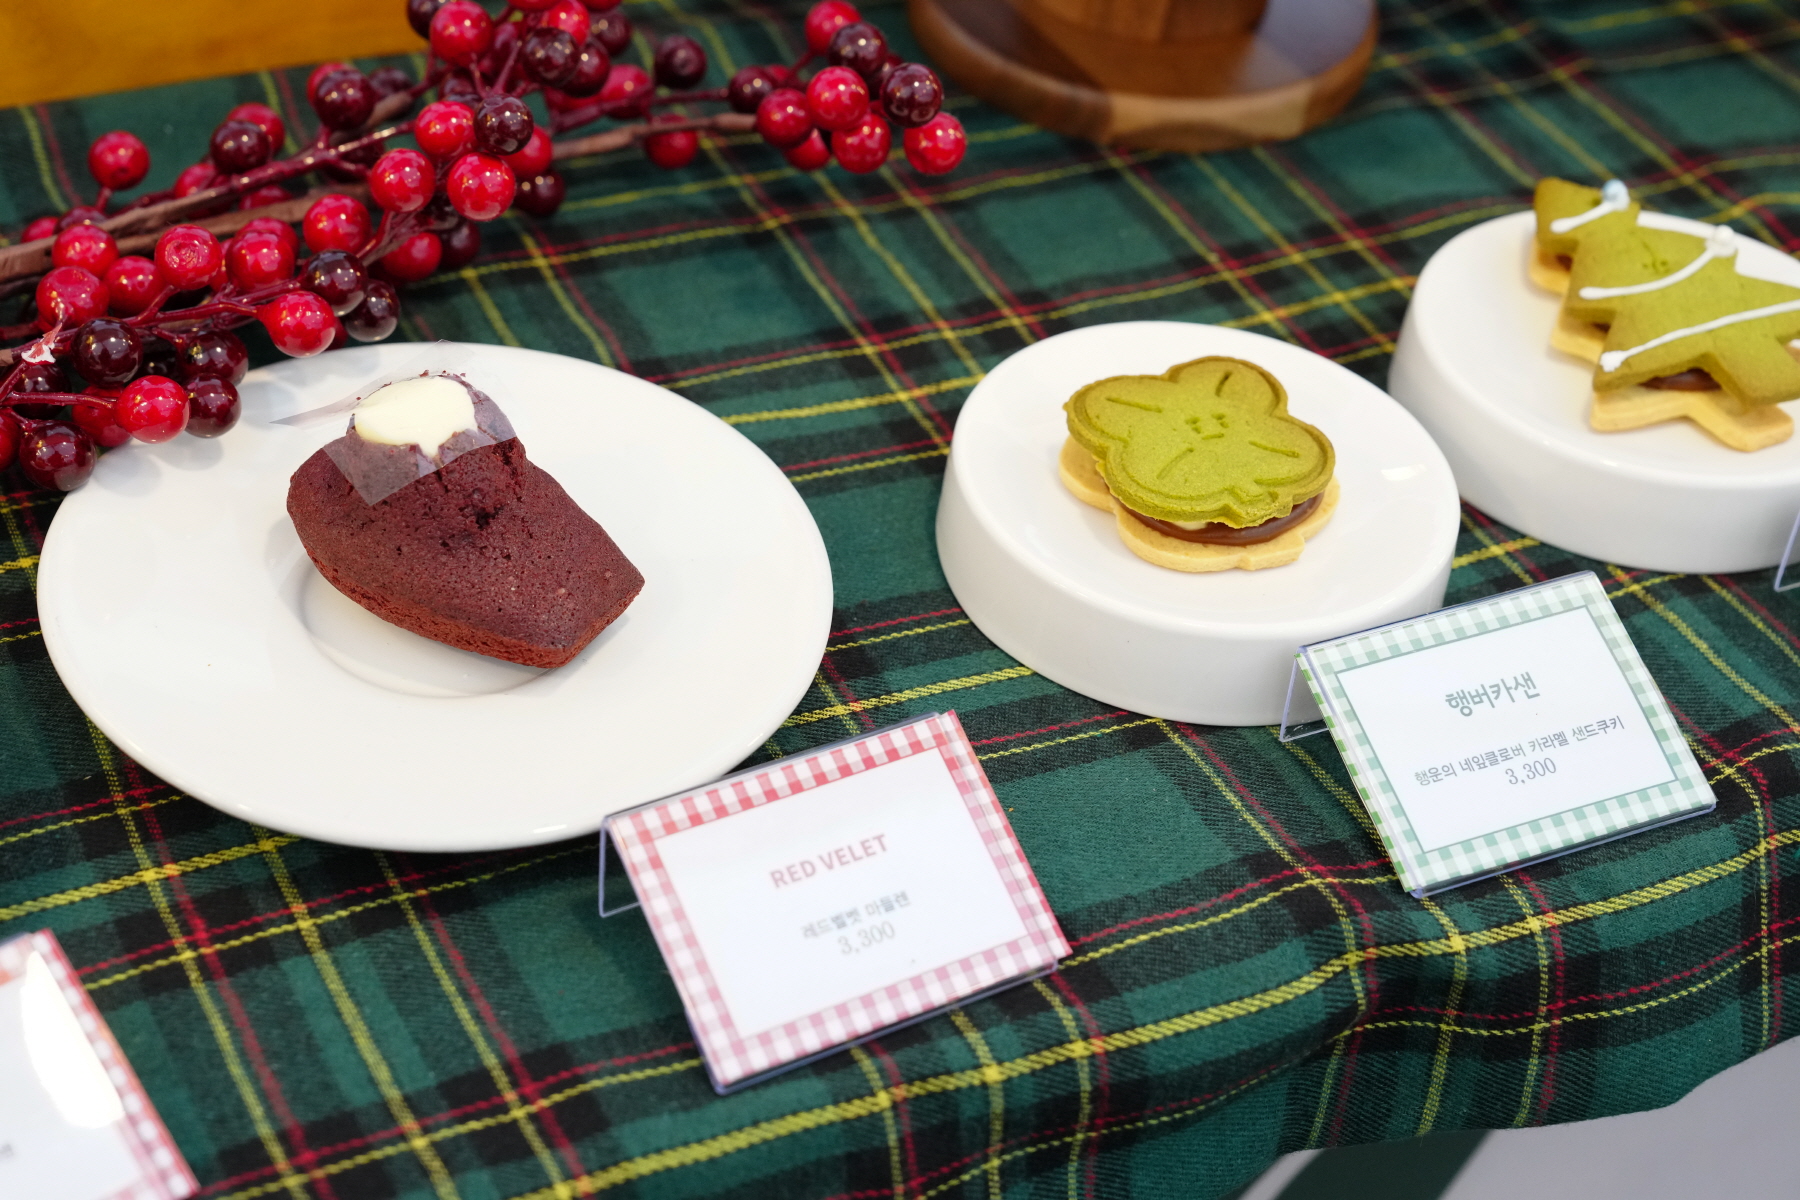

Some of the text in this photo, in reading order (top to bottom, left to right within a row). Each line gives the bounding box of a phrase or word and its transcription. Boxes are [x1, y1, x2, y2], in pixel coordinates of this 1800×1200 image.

[1445, 671, 1540, 717] 행버카샌
[1415, 715, 1625, 786] 행운의 네잎클로버 카라멜 샌드쿠키
[1505, 757, 1557, 785] 3,300
[770, 833, 888, 888] RED VELET
[865, 891, 910, 916] 마들렌
[838, 921, 895, 955] 3,300
